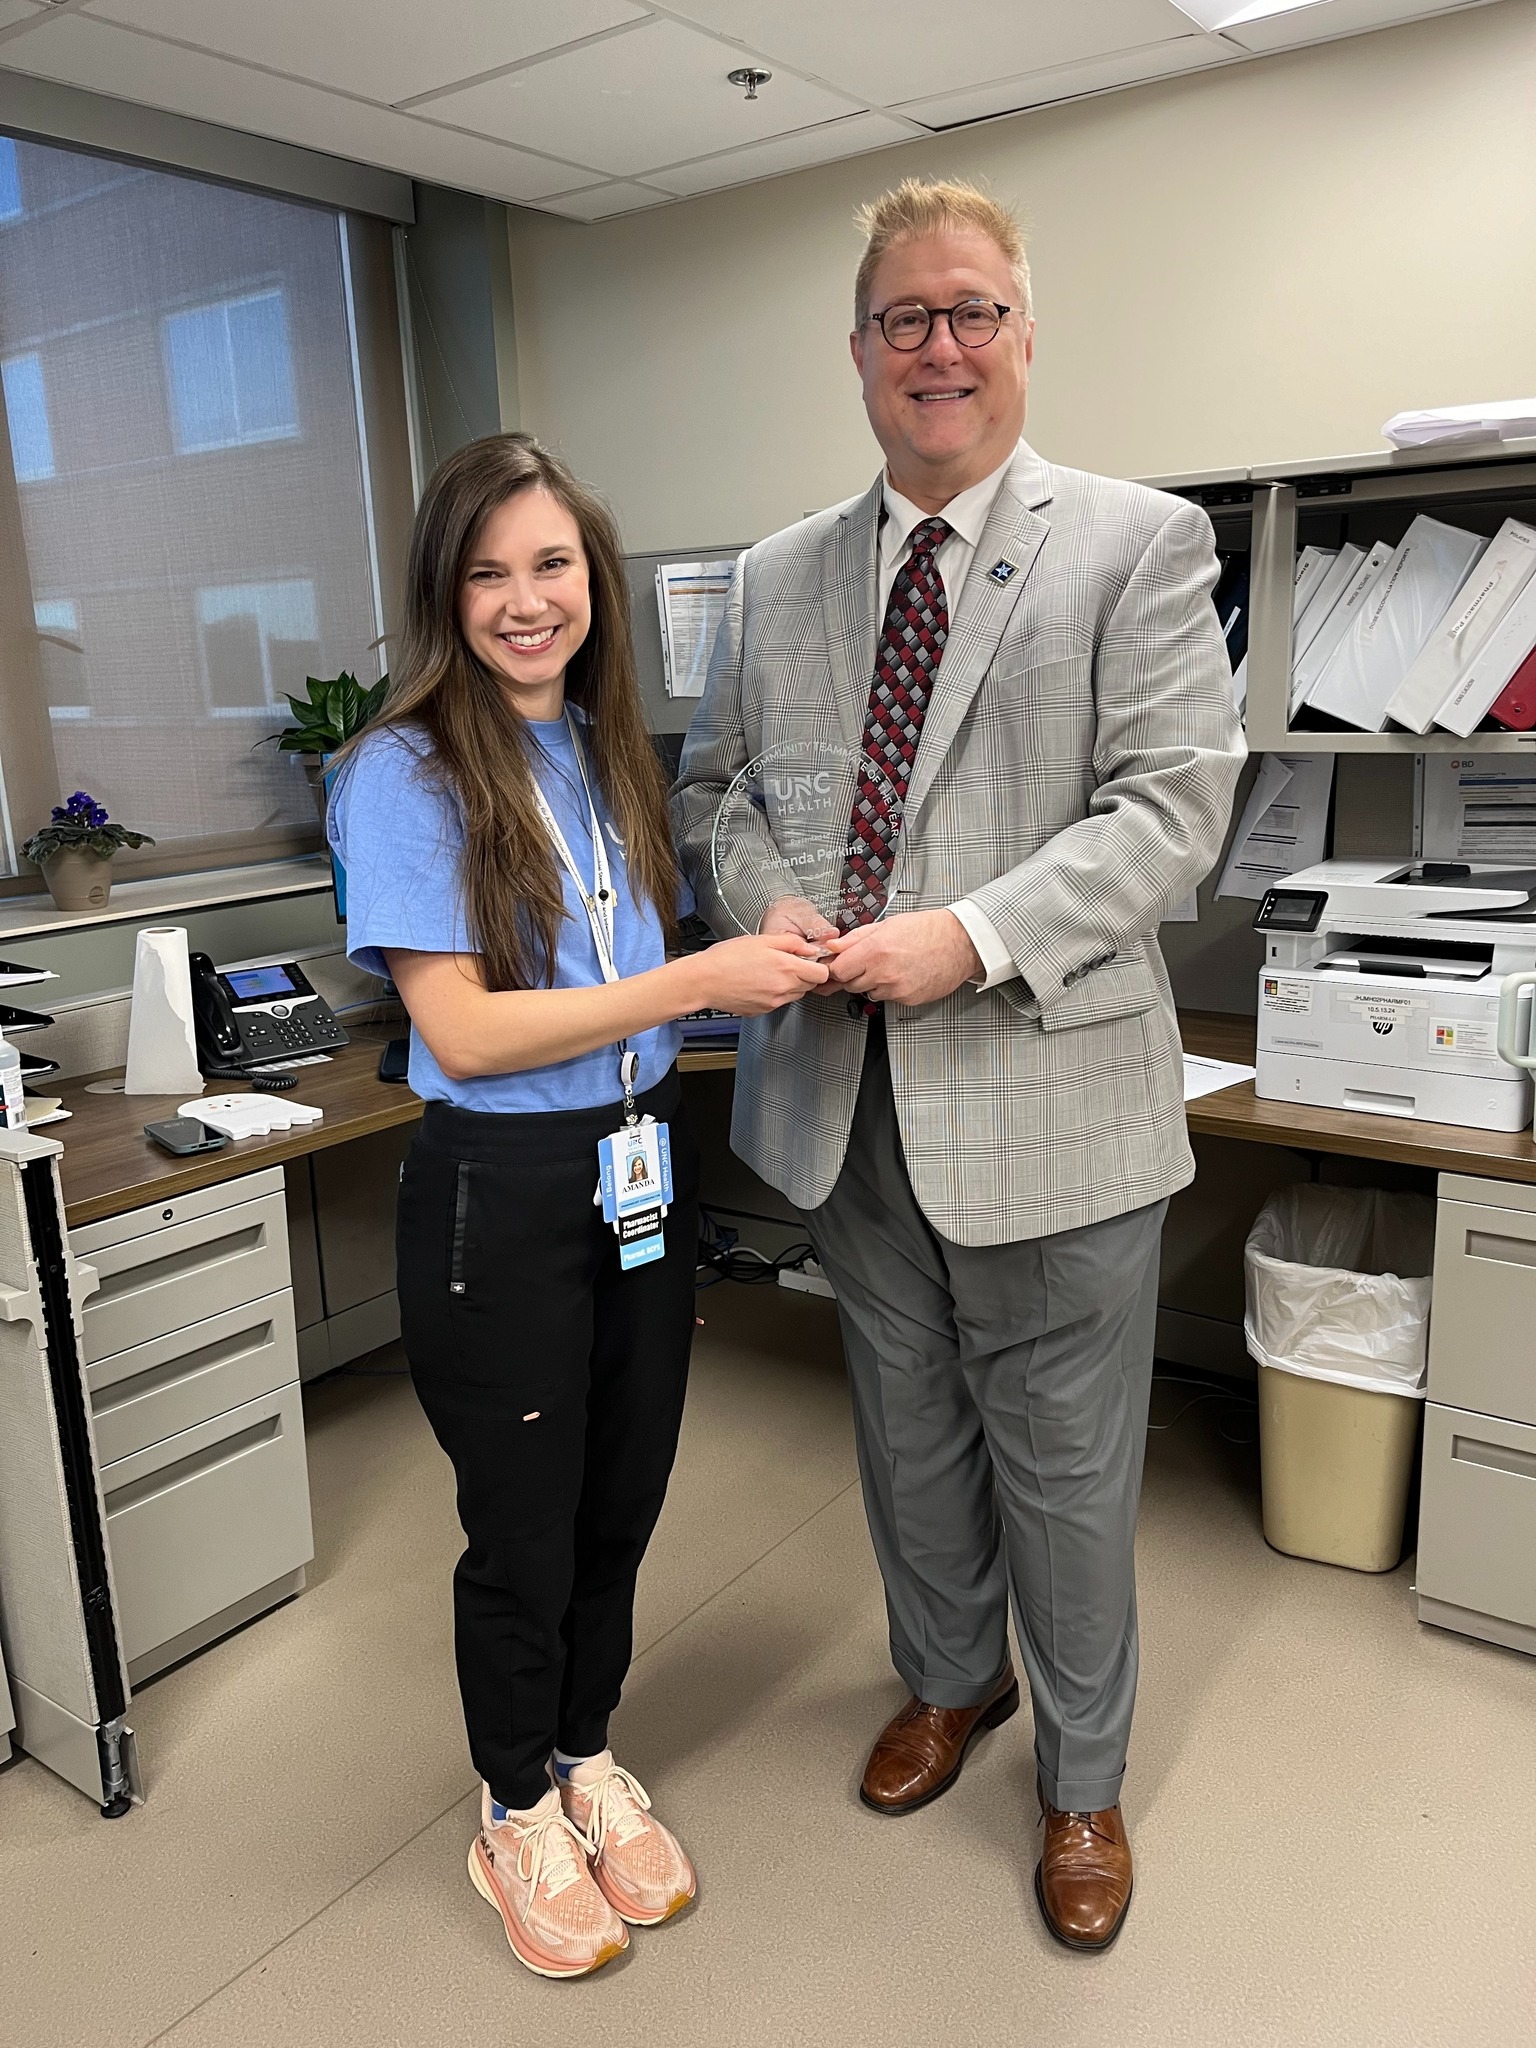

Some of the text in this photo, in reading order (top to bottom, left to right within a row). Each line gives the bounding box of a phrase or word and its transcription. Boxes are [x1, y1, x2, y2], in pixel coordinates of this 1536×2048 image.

[747, 741, 812, 778] COMMUNITY
[1461, 760, 1475, 768] BD
[775, 771, 831, 801] UNC
[867, 768, 882, 785] OF
[878, 782, 893, 806] THE
[717, 775, 749, 840] PHARMACY
[777, 797, 832, 816] HEALTH
[886, 806, 899, 838] YEAR
[716, 842, 726, 871] ONE
[761, 844, 864, 872] Amanda Perkins
[1367, 1006, 1396, 1014] 10.5.13.24
[627, 1137, 643, 1147] UNC
[661, 1148, 669, 1166] UNC
[605, 1164, 613, 1193] Belong
[621, 1178, 656, 1194] AMANDA
[662, 1167, 670, 1192] Health
[622, 1212, 659, 1230] Pharmacist
[622, 1221, 660, 1239] Coordinator
